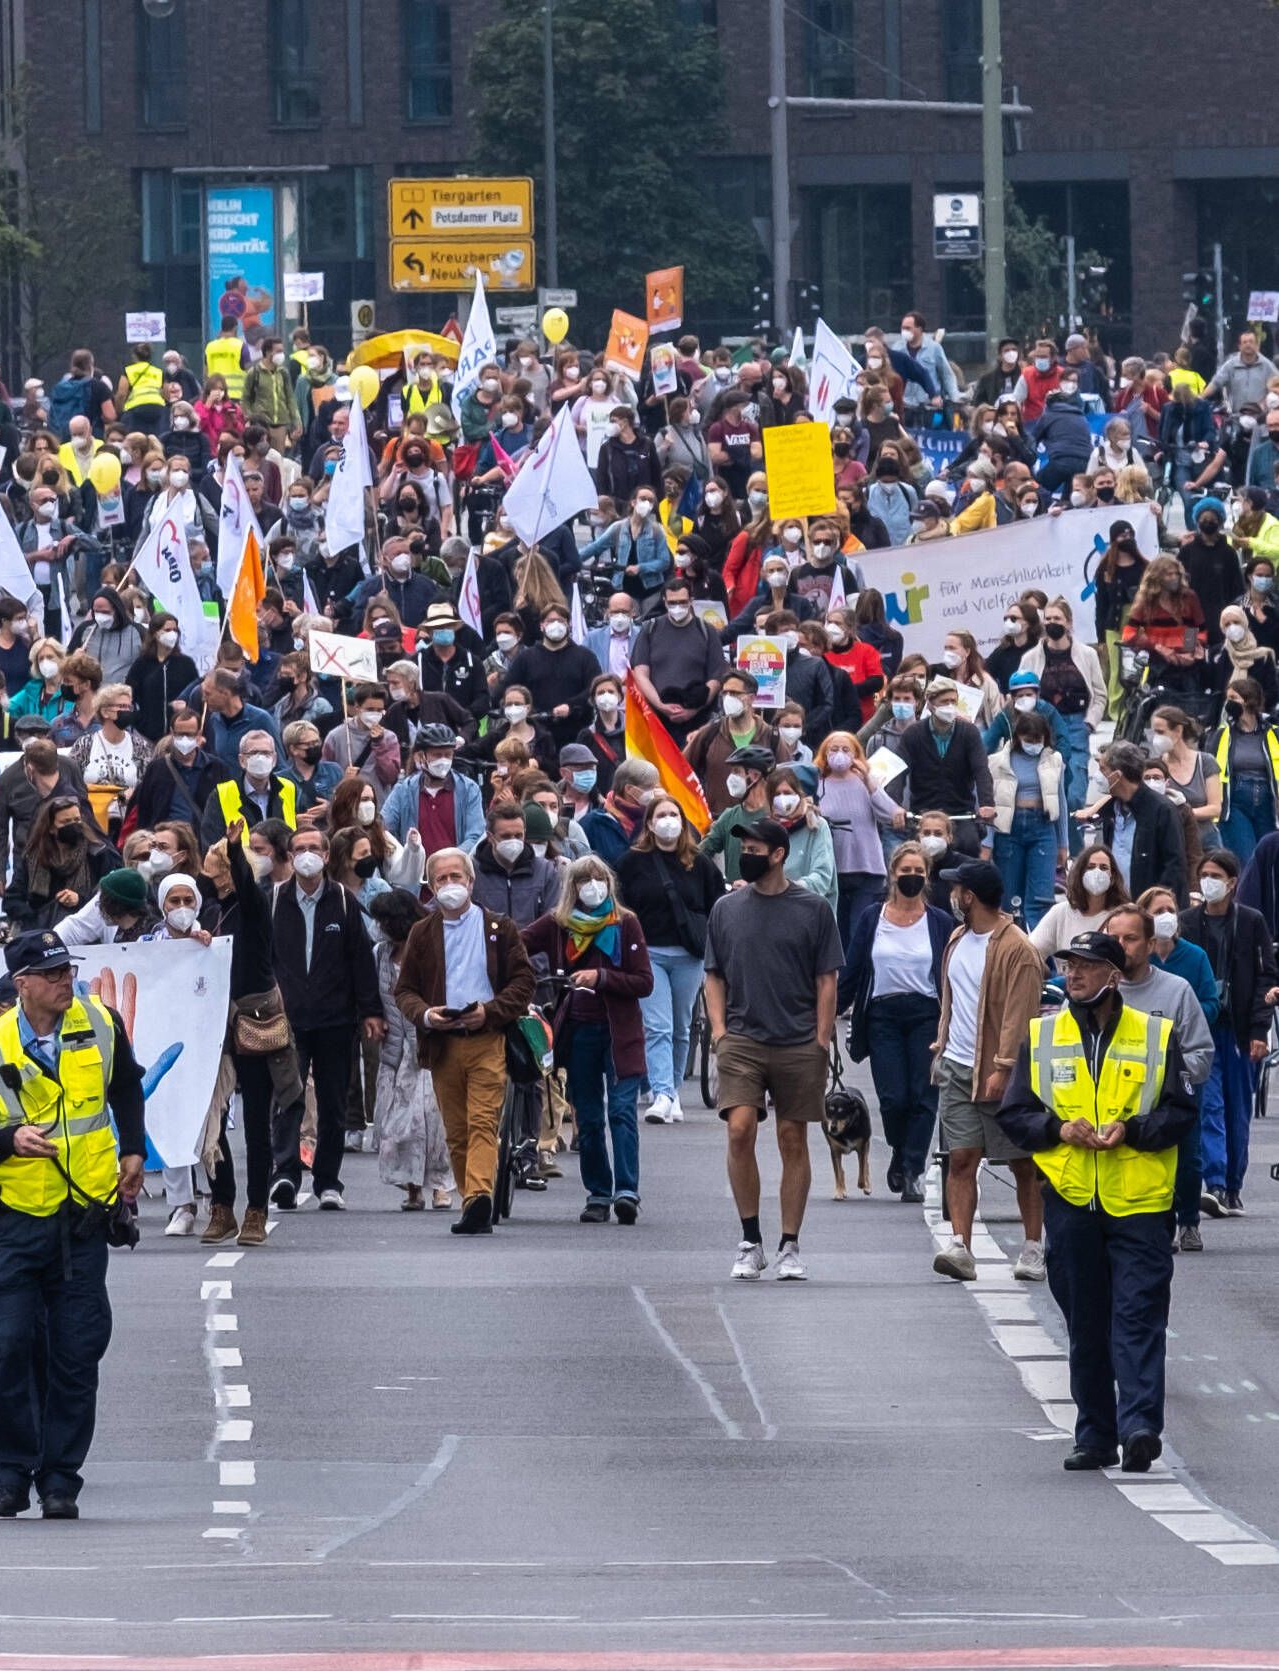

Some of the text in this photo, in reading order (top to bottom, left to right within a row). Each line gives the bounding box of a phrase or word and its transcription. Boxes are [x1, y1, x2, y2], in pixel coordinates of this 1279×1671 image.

[432, 189, 501, 205] Tiergarten
[435, 210, 519, 224] Potsdamer Platz
[725, 433, 750, 446] VANS
[939, 563, 1074, 598] für Menschlichkeit
[942, 592, 1023, 618] und Vielfal
